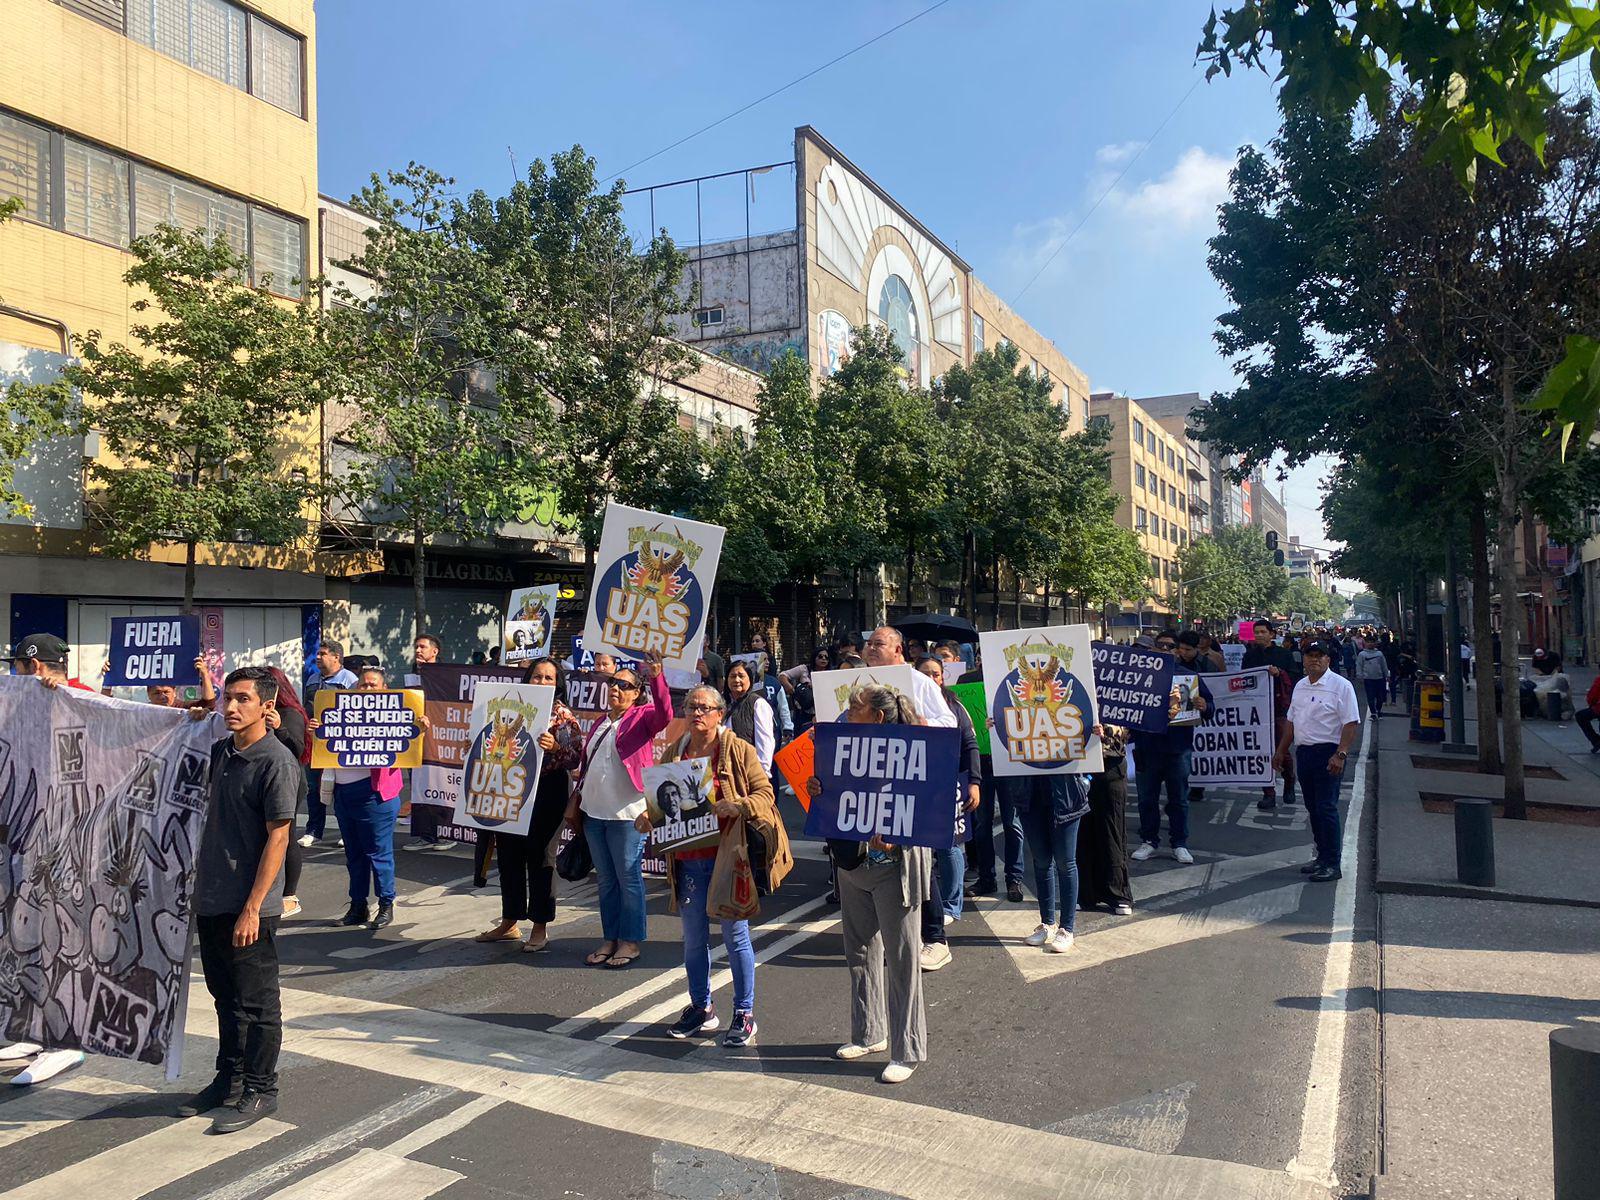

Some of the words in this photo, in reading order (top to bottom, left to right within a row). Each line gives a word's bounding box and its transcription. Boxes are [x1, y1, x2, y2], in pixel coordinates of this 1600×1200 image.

[533, 572, 585, 583] ZAPATE
[608, 589, 689, 635] UAS
[123, 621, 182, 647] FUERA
[602, 621, 685, 659] LIBRE
[125, 648, 175, 680] CUÉN
[1091, 648, 1108, 663] DO
[1110, 651, 1126, 665] EL
[1128, 653, 1164, 671] PESO
[1099, 668, 1115, 681] LA
[1117, 670, 1142, 686] LEY
[1144, 674, 1154, 688] A
[338, 694, 400, 710] ROCHA
[765, 686, 775, 700] P
[1095, 685, 1162, 707] CUENISTAS
[344, 710, 363, 723] SE
[365, 710, 413, 724] PUEDE!
[446, 707, 460, 722] En
[1005, 704, 1083, 739] UAS
[1102, 704, 1144, 724] BASTA!
[1249, 706, 1261, 726] A
[324, 726, 342, 737] NO
[344, 726, 413, 738] QUEREMOS
[1192, 731, 1239, 752] OBAN
[1242, 731, 1261, 751] EL
[333, 740, 350, 751] AL
[352, 738, 383, 752] CUÉN
[386, 740, 403, 752] EN
[438, 745, 456, 760] por
[1008, 737, 1086, 761] LIBRE
[345, 754, 361, 765] LA
[364, 754, 389, 766] UAS
[833, 736, 927, 782] FUERA
[1190, 755, 1270, 776] UDIANTES"
[447, 773, 462, 786] sie
[470, 761, 526, 797] UAS
[424, 788, 458, 802] conve
[465, 793, 521, 821] LIBRE
[836, 782, 916, 838] CUÉN
[436, 825, 452, 839] por
[453, 828, 463, 840] el
[464, 829, 478, 843] bie
[651, 821, 687, 845] FUERA
[687, 812, 718, 837] CUÉN
